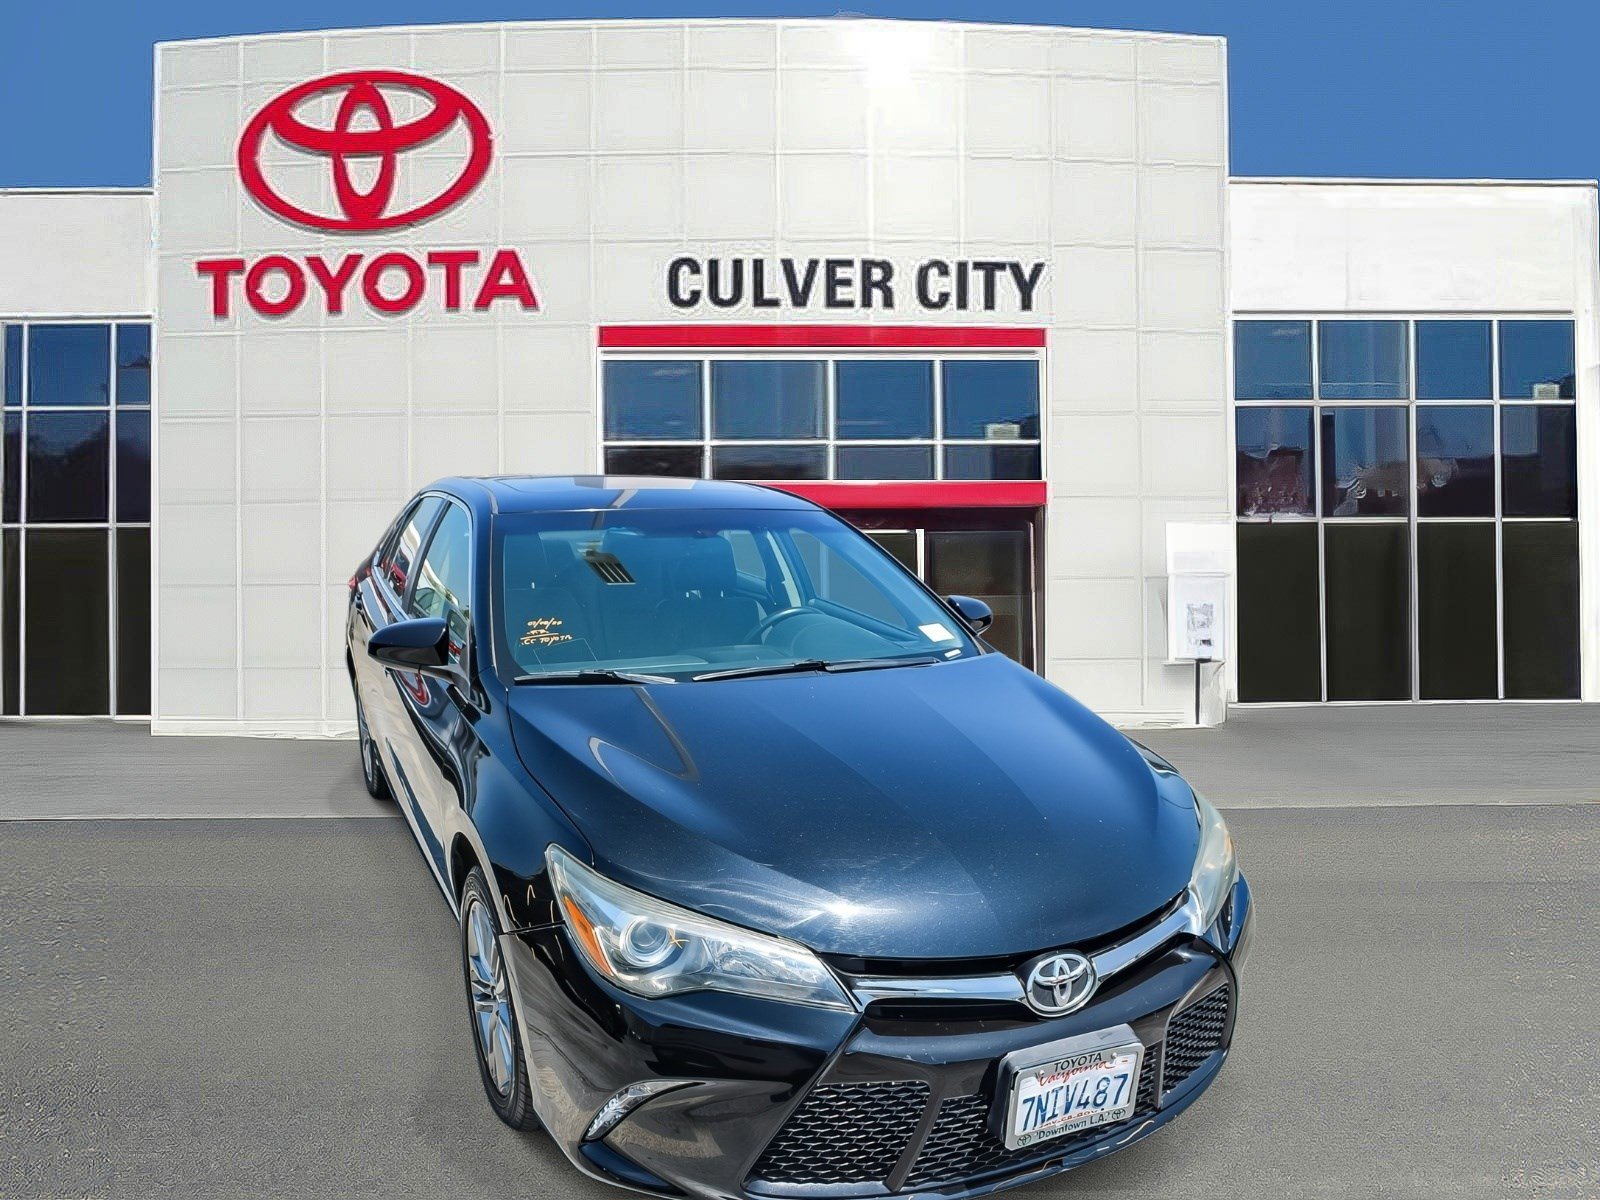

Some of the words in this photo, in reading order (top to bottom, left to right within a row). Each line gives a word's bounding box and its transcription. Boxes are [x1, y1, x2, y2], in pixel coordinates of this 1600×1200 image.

[196, 249, 538, 319] TOYOTA
[668, 257, 895, 308] CULVER
[915, 259, 1045, 311] CITY
[1054, 1052, 1102, 1072] TOYOTA
[1022, 1073, 1129, 1132] 7NIV487
